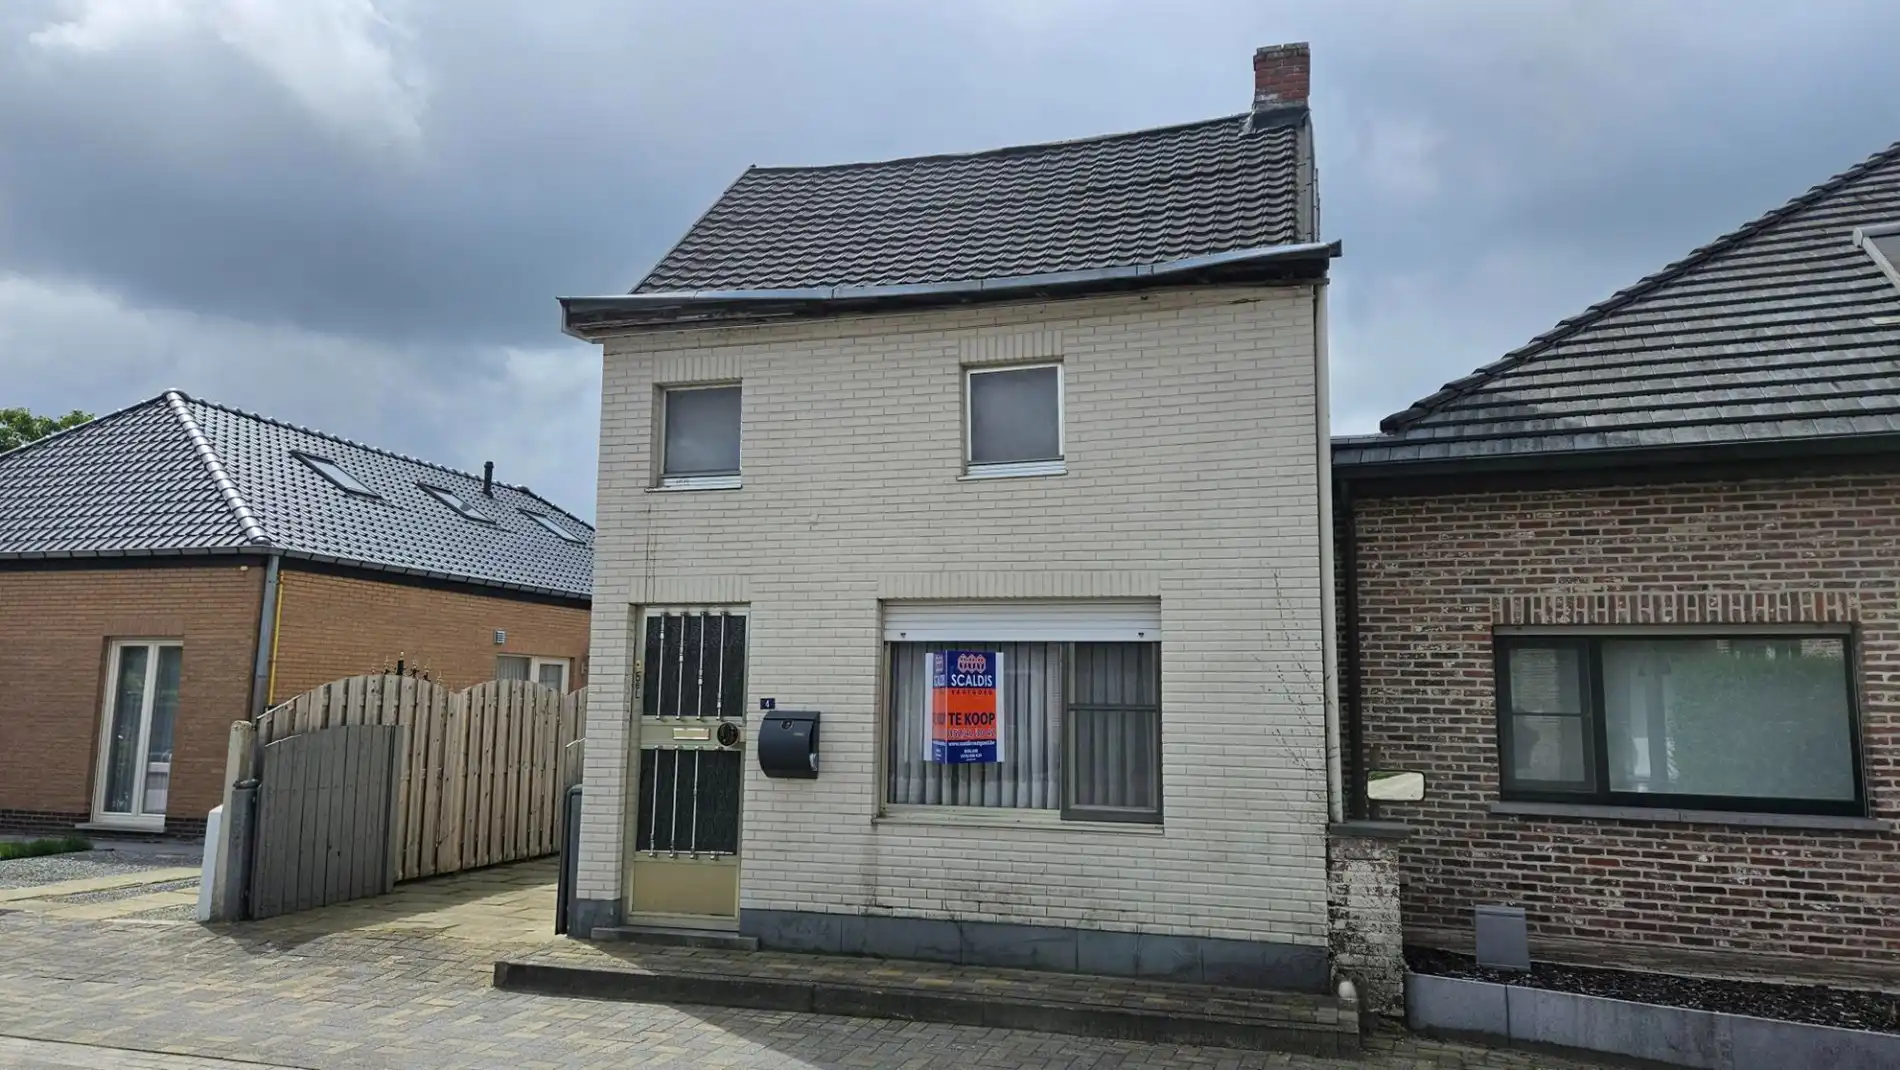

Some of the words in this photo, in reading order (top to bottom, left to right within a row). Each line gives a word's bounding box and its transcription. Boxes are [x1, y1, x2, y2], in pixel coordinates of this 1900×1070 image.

[951, 674, 993, 687] SCALDIS
[765, 700, 770, 708] 4
[948, 712, 962, 725] TE
[964, 712, 995, 725] KOOP
